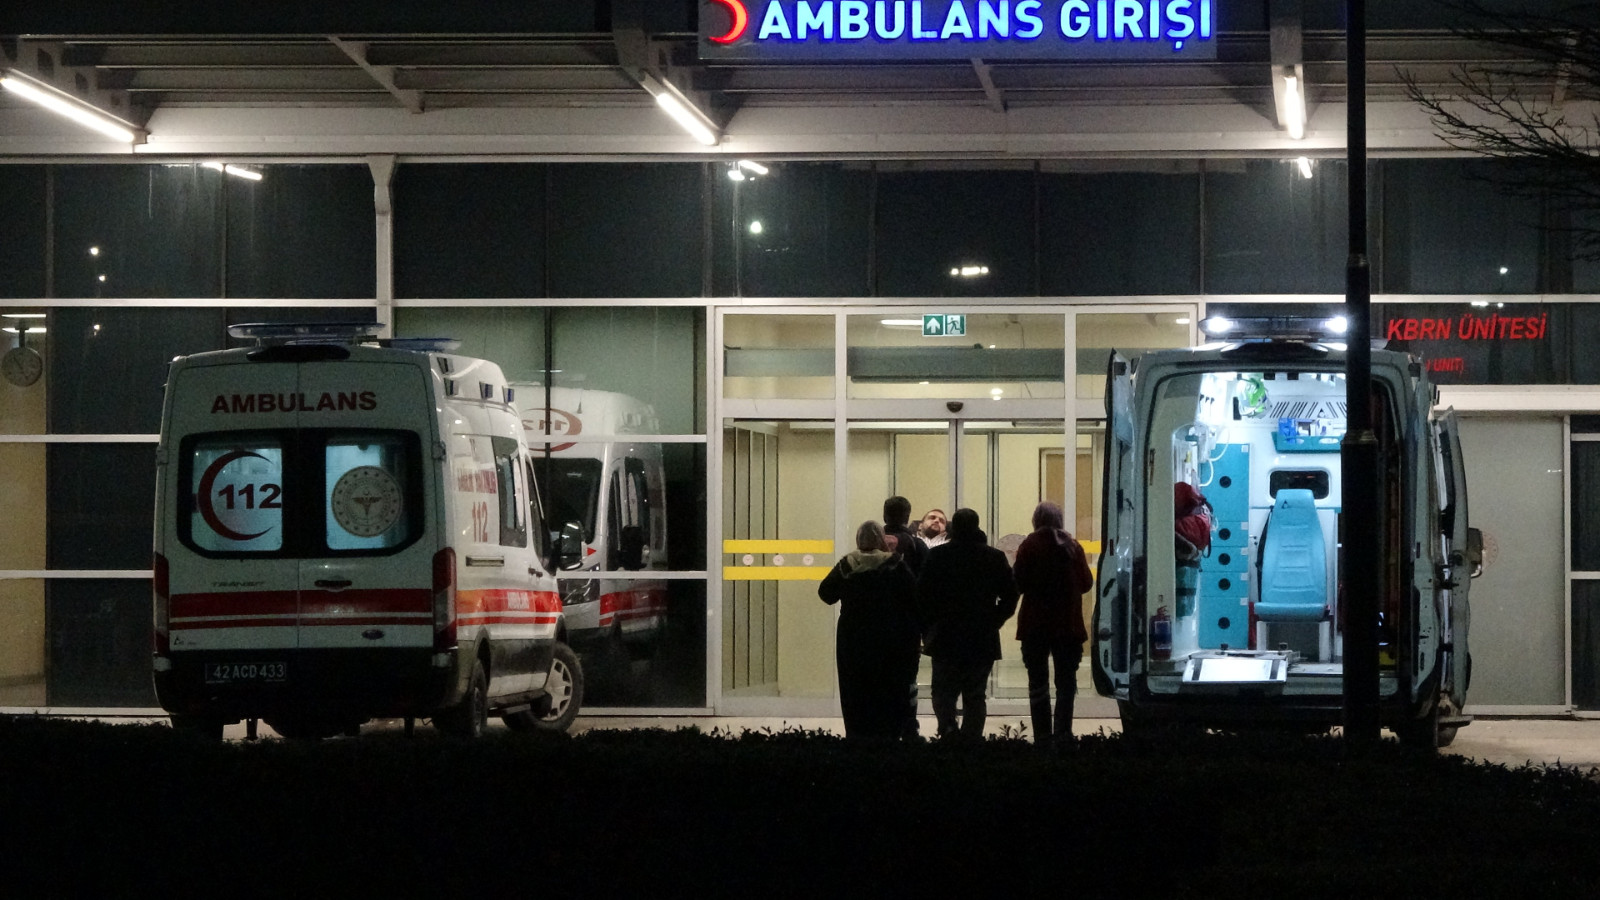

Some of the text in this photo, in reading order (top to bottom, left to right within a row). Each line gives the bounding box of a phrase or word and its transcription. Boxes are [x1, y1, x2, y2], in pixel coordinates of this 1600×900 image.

[758, 0, 1044, 40] AMBULANS
[1387, 313, 1548, 341] KBRN ÜNİTESİ
[211, 391, 377, 414] AMBULANS
[218, 483, 282, 510] 112
[472, 501, 488, 543] 112
[213, 664, 284, 679] 42 ACD 433
